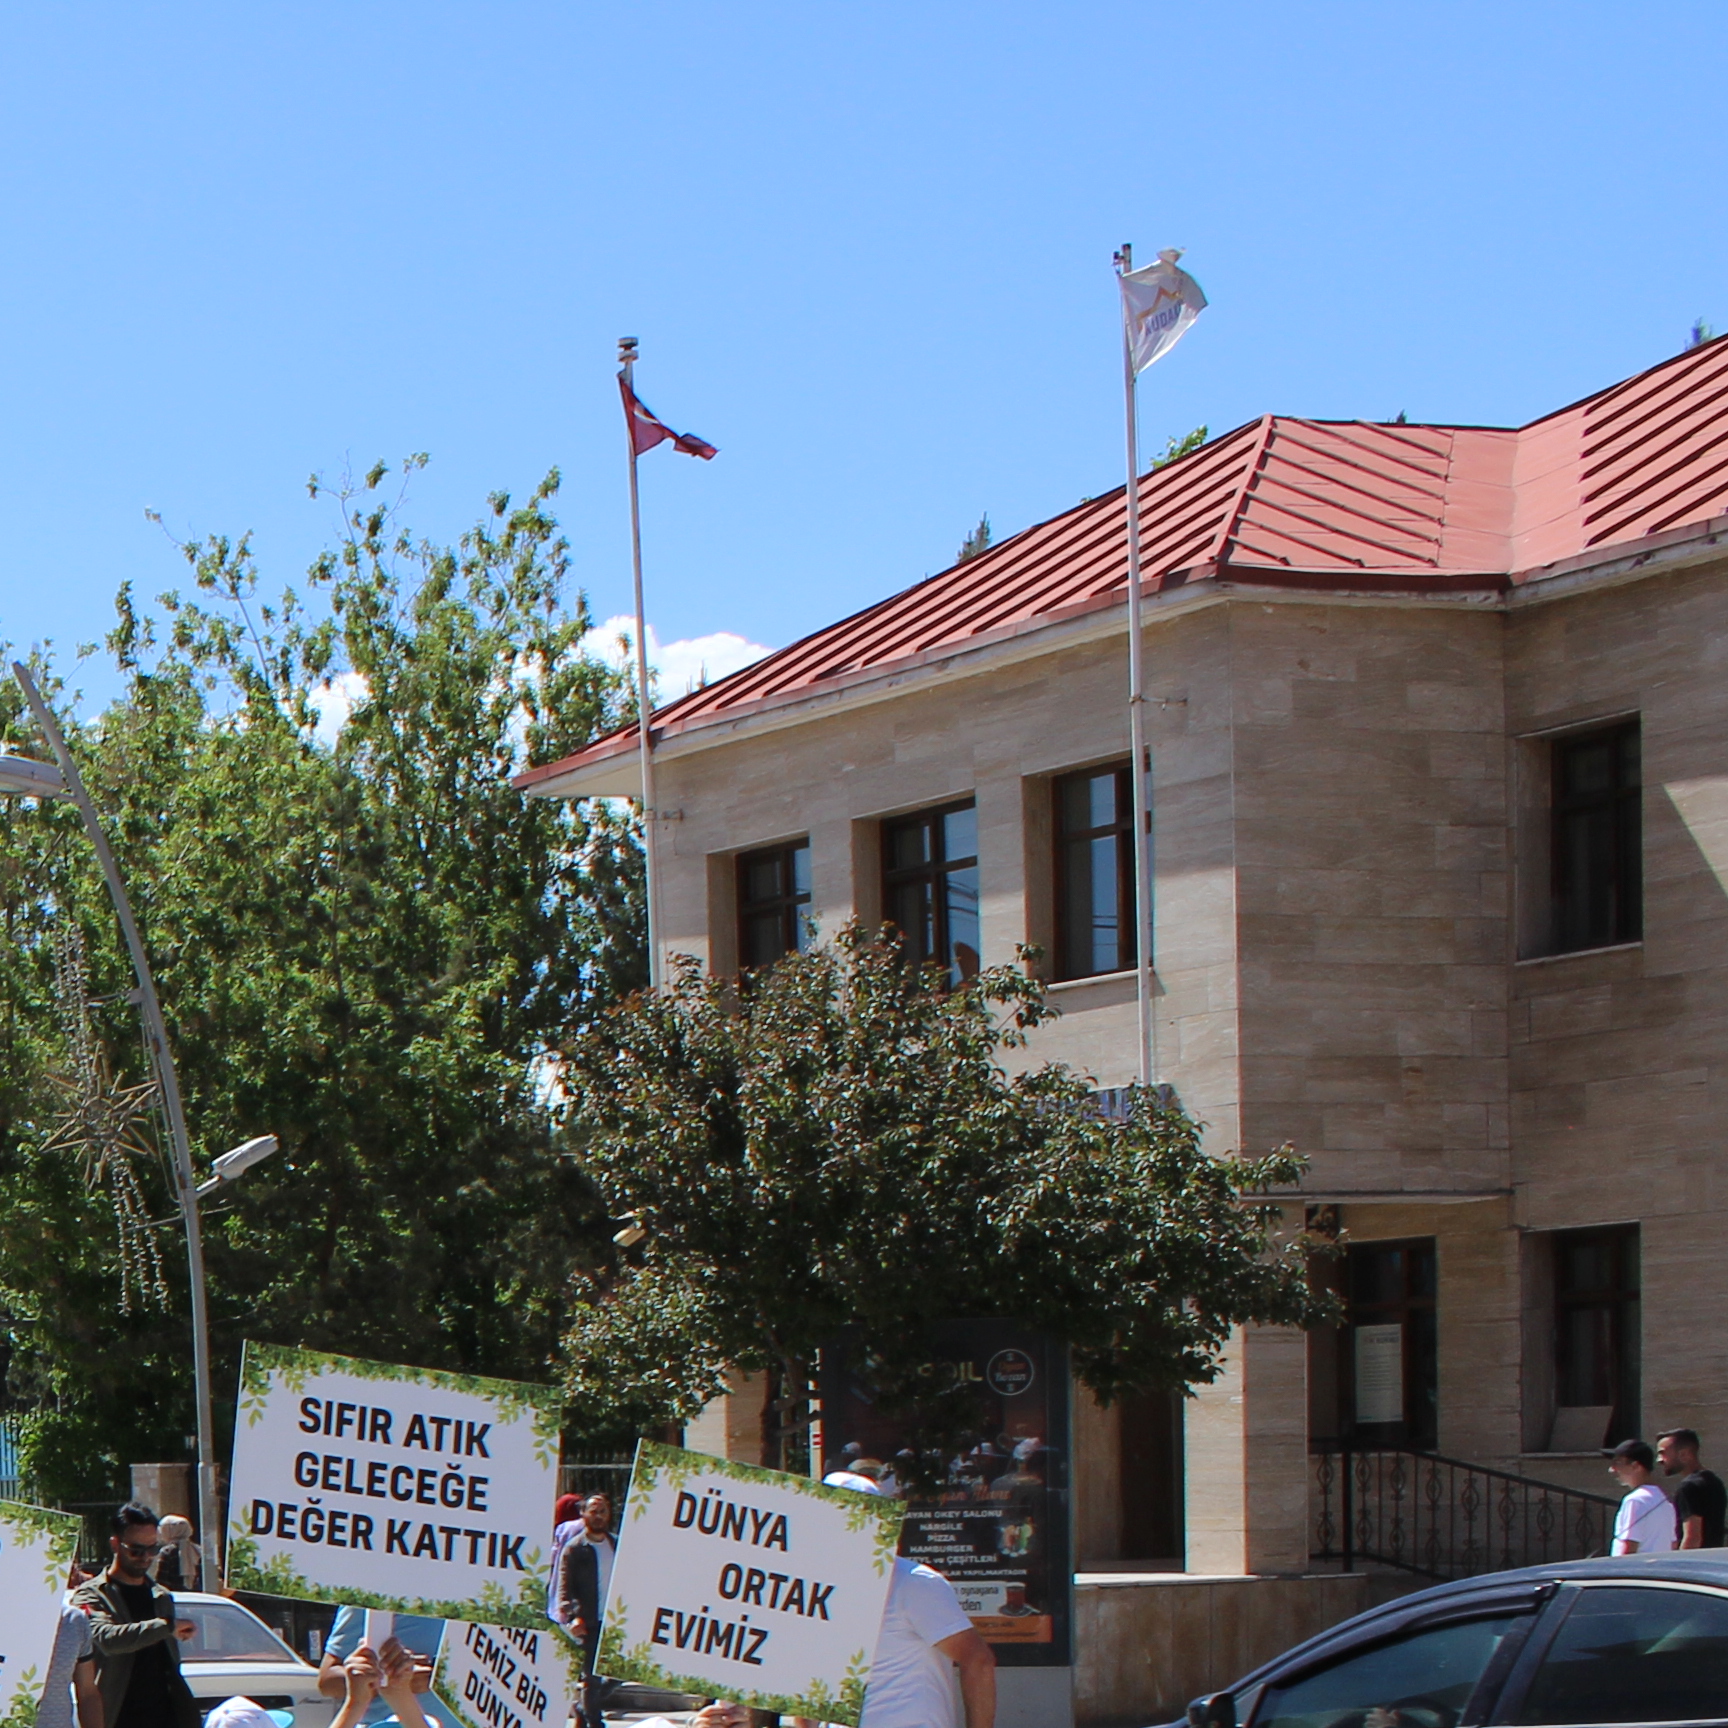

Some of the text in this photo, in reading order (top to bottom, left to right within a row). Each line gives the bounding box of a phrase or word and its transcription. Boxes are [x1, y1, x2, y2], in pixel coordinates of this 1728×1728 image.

[298, 1397, 492, 1459] SIFIR ATIK
[294, 1451, 490, 1512] GELECEĞE
[250, 1497, 527, 1571] DEĞER KATTIK
[672, 1488, 788, 1552] DÜNYA
[904, 1510, 1003, 1519] AYAN OKEY SALONU
[919, 1521, 964, 1531] NARGİLE
[910, 1544, 974, 1553] HAMBURGER
[946, 1553, 997, 1566] ÇEŞİTLERİ
[718, 1563, 835, 1621] ORTAK
[650, 1605, 769, 1666] EVİMİZ
[464, 1623, 547, 1722] TEMİZ BİR
